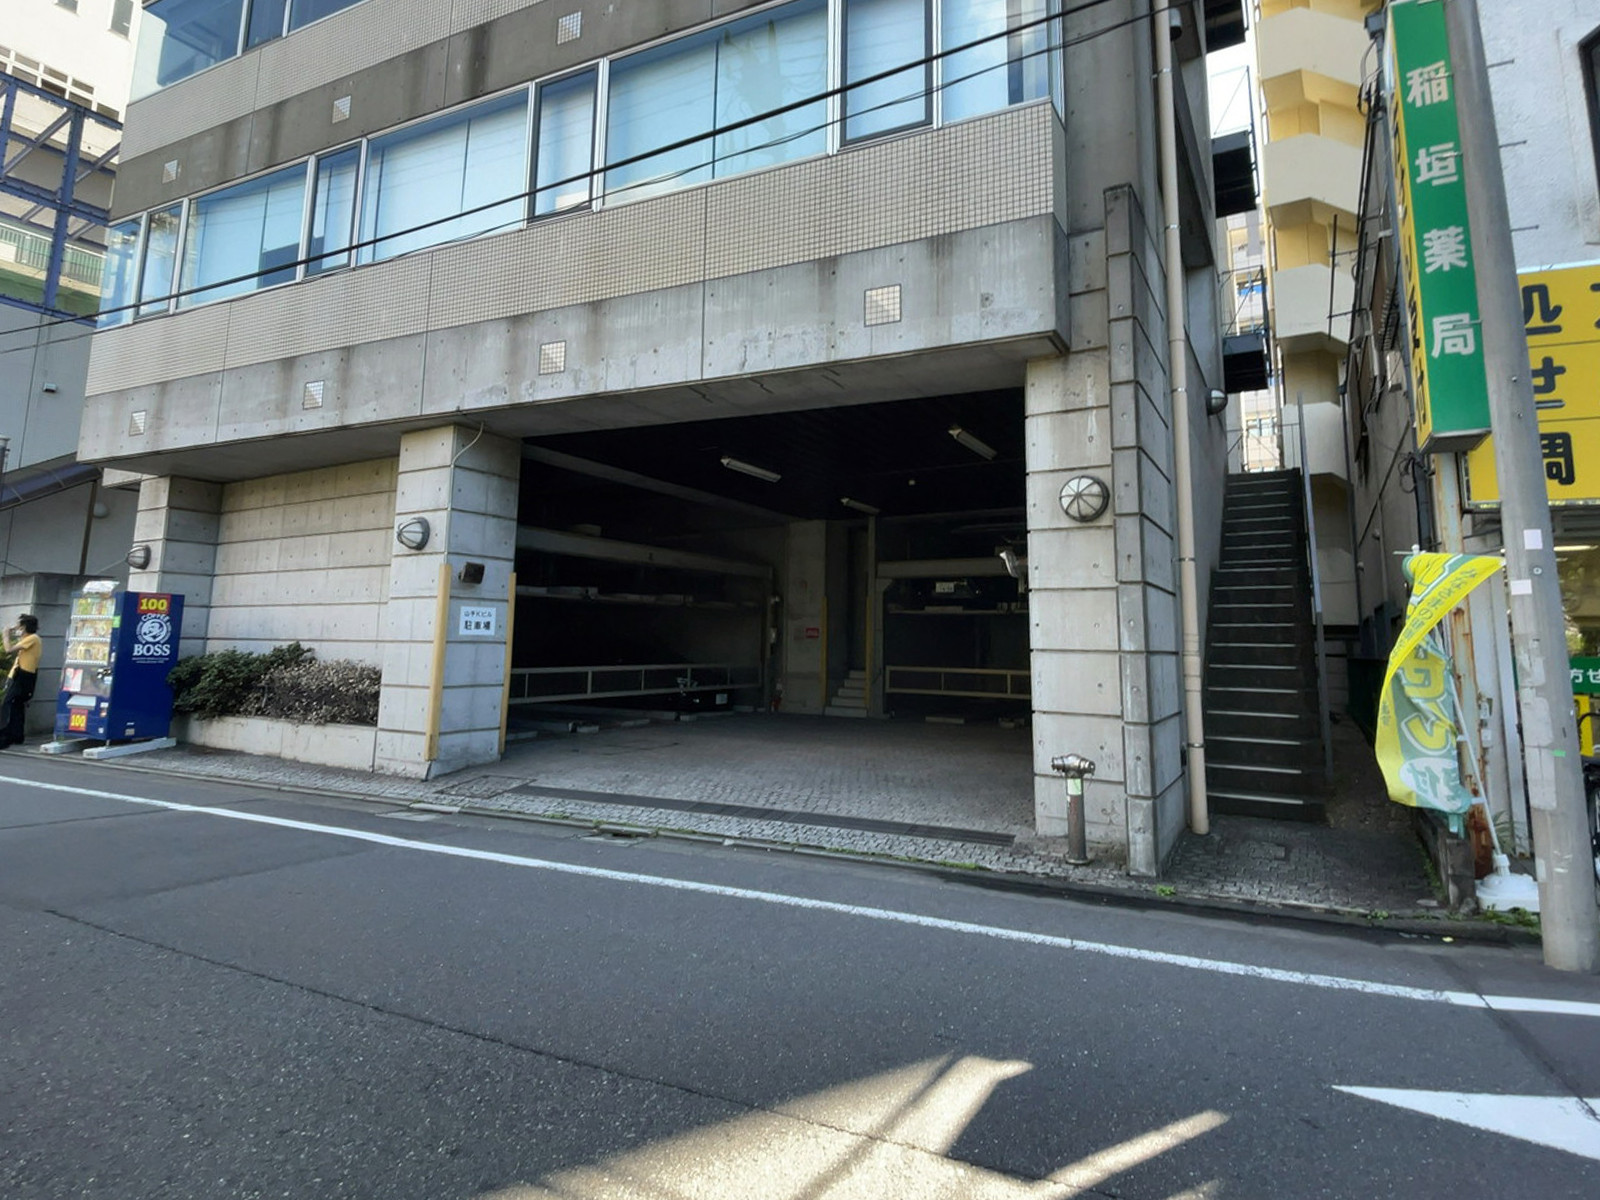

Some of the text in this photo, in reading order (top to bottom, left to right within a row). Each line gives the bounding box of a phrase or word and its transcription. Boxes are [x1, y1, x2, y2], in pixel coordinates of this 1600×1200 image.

[1406, 61, 1475, 359] 稲垣薬局
[141, 598, 168, 611] 100
[464, 620, 491, 630] 駐車場
[133, 644, 171, 656] BOSS
[71, 714, 86, 727] 100
